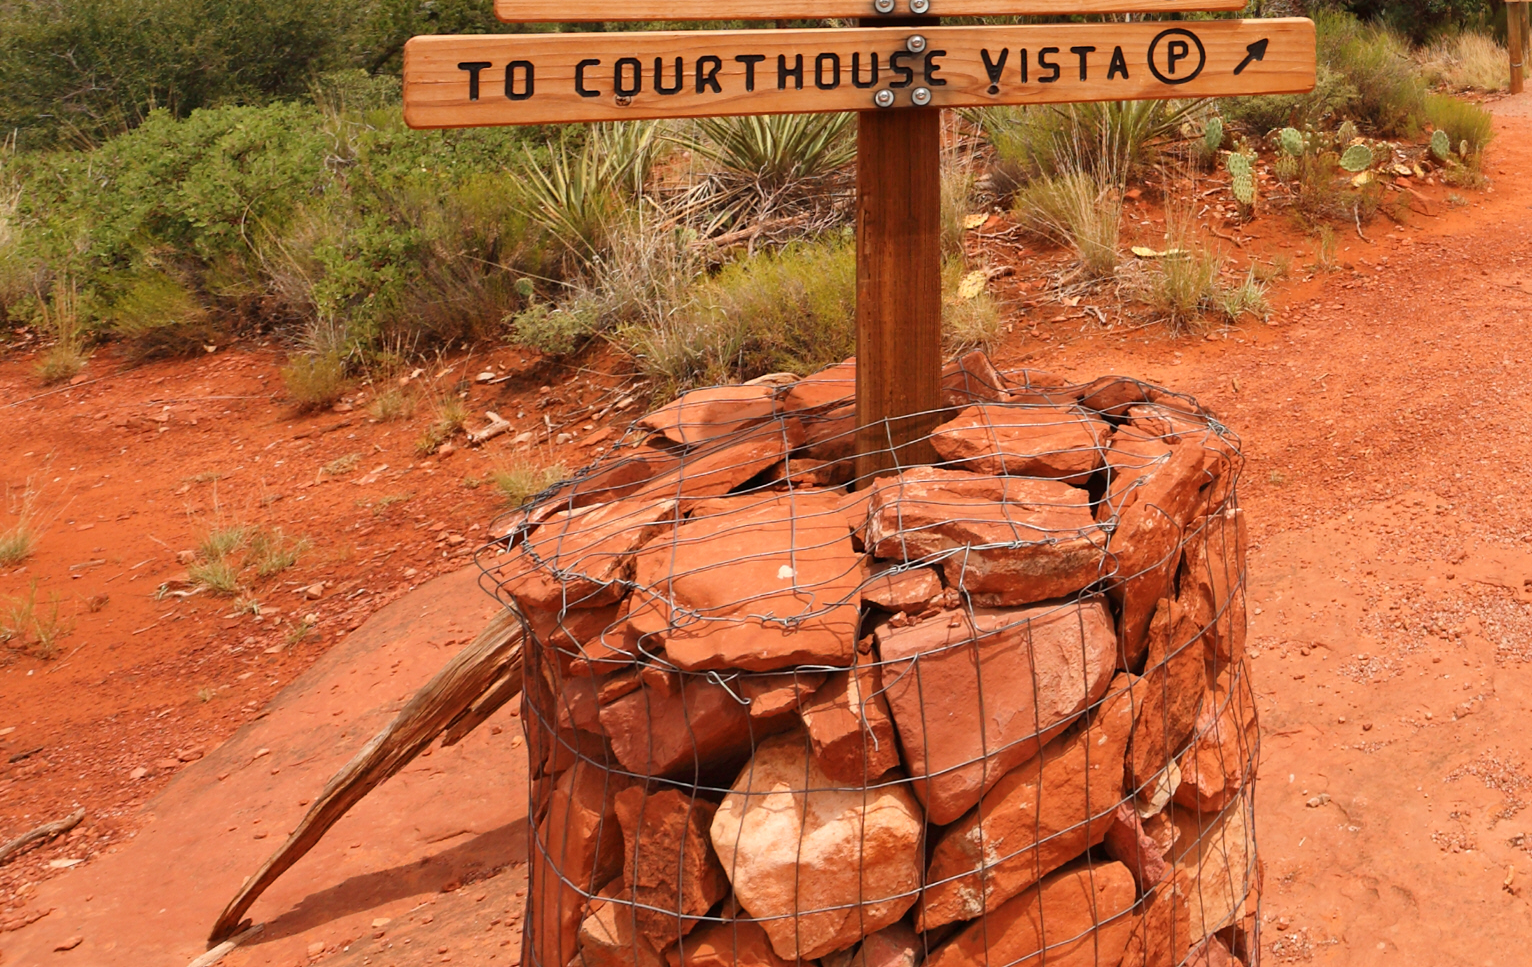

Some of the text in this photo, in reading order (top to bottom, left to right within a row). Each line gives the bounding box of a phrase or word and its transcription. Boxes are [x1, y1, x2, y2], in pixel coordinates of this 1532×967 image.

[457, 59, 535, 102] TO
[574, 49, 948, 98] COURTHOUSE
[980, 45, 1129, 85] VISTA
